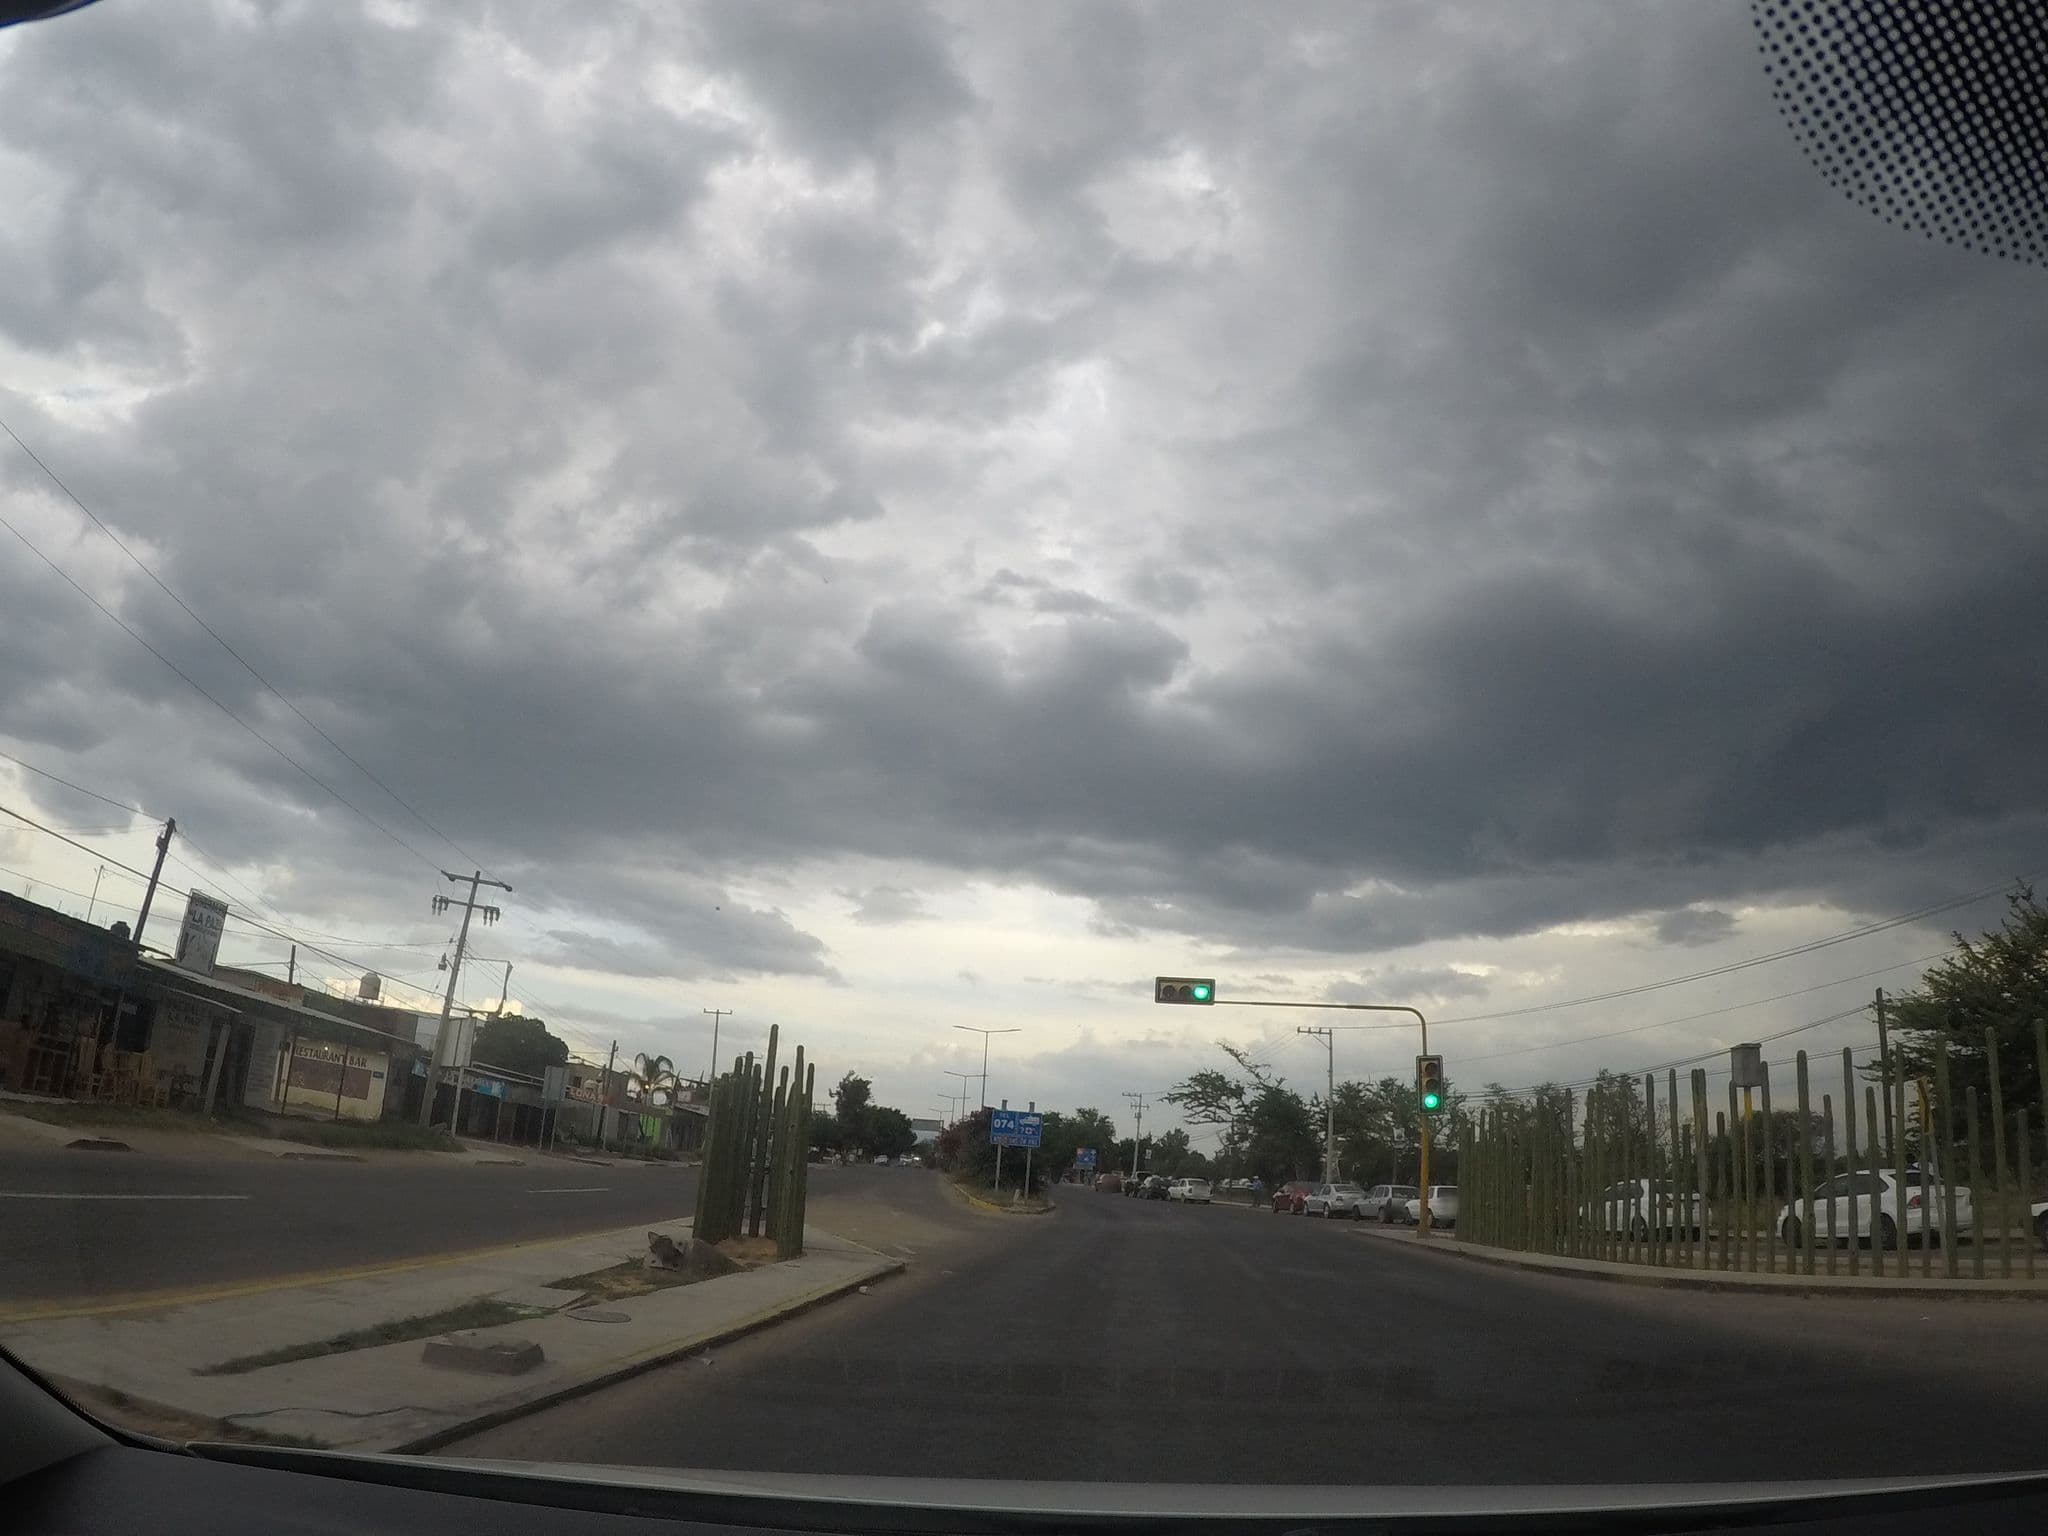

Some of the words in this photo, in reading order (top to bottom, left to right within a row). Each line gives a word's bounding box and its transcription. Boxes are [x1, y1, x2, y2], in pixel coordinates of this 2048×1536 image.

[294, 1046, 346, 1065] RESTAURANT
[349, 1056, 368, 1068] BAR
[993, 1119, 1015, 1130] 074
